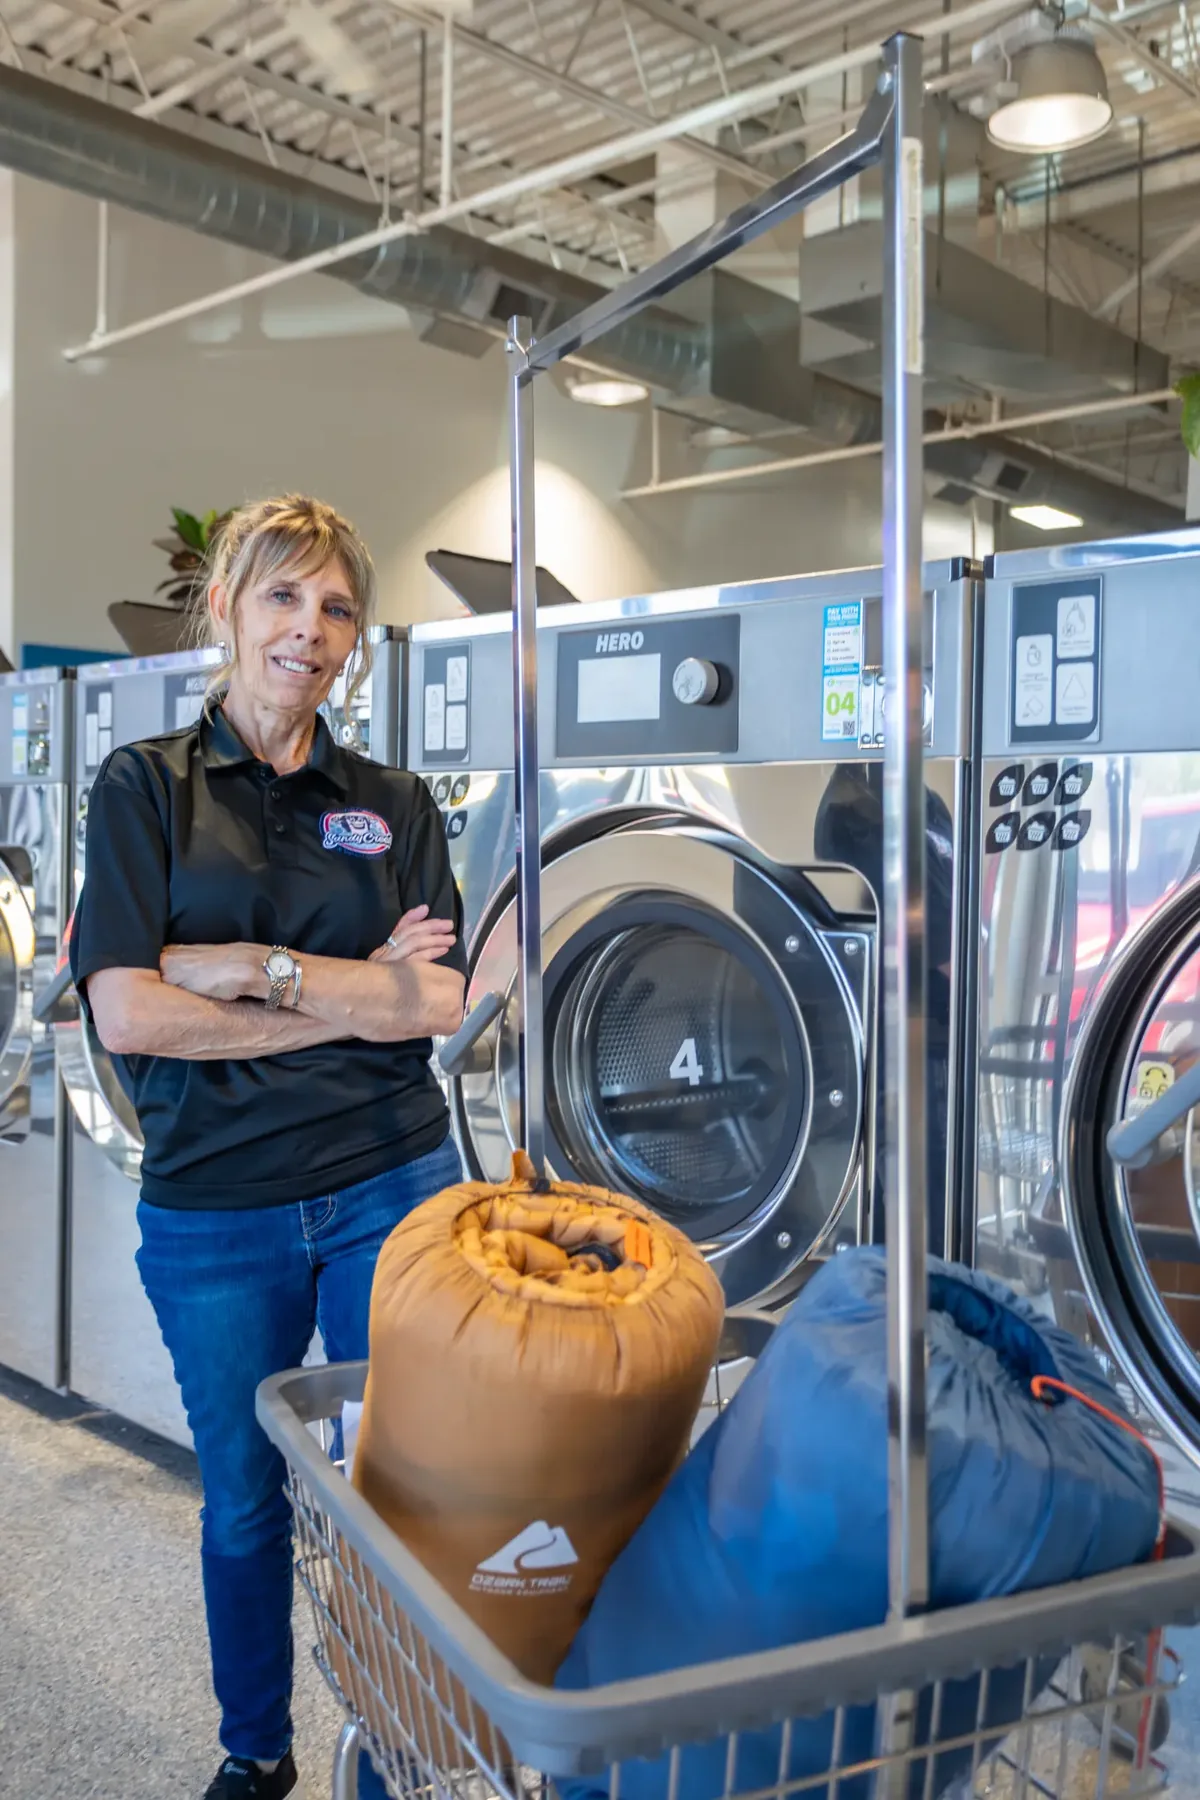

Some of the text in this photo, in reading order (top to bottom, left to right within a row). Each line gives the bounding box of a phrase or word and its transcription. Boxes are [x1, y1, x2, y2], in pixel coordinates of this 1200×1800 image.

[595, 631, 644, 653] HERO
[826, 692, 855, 716] 04
[669, 1037, 703, 1087] 4
